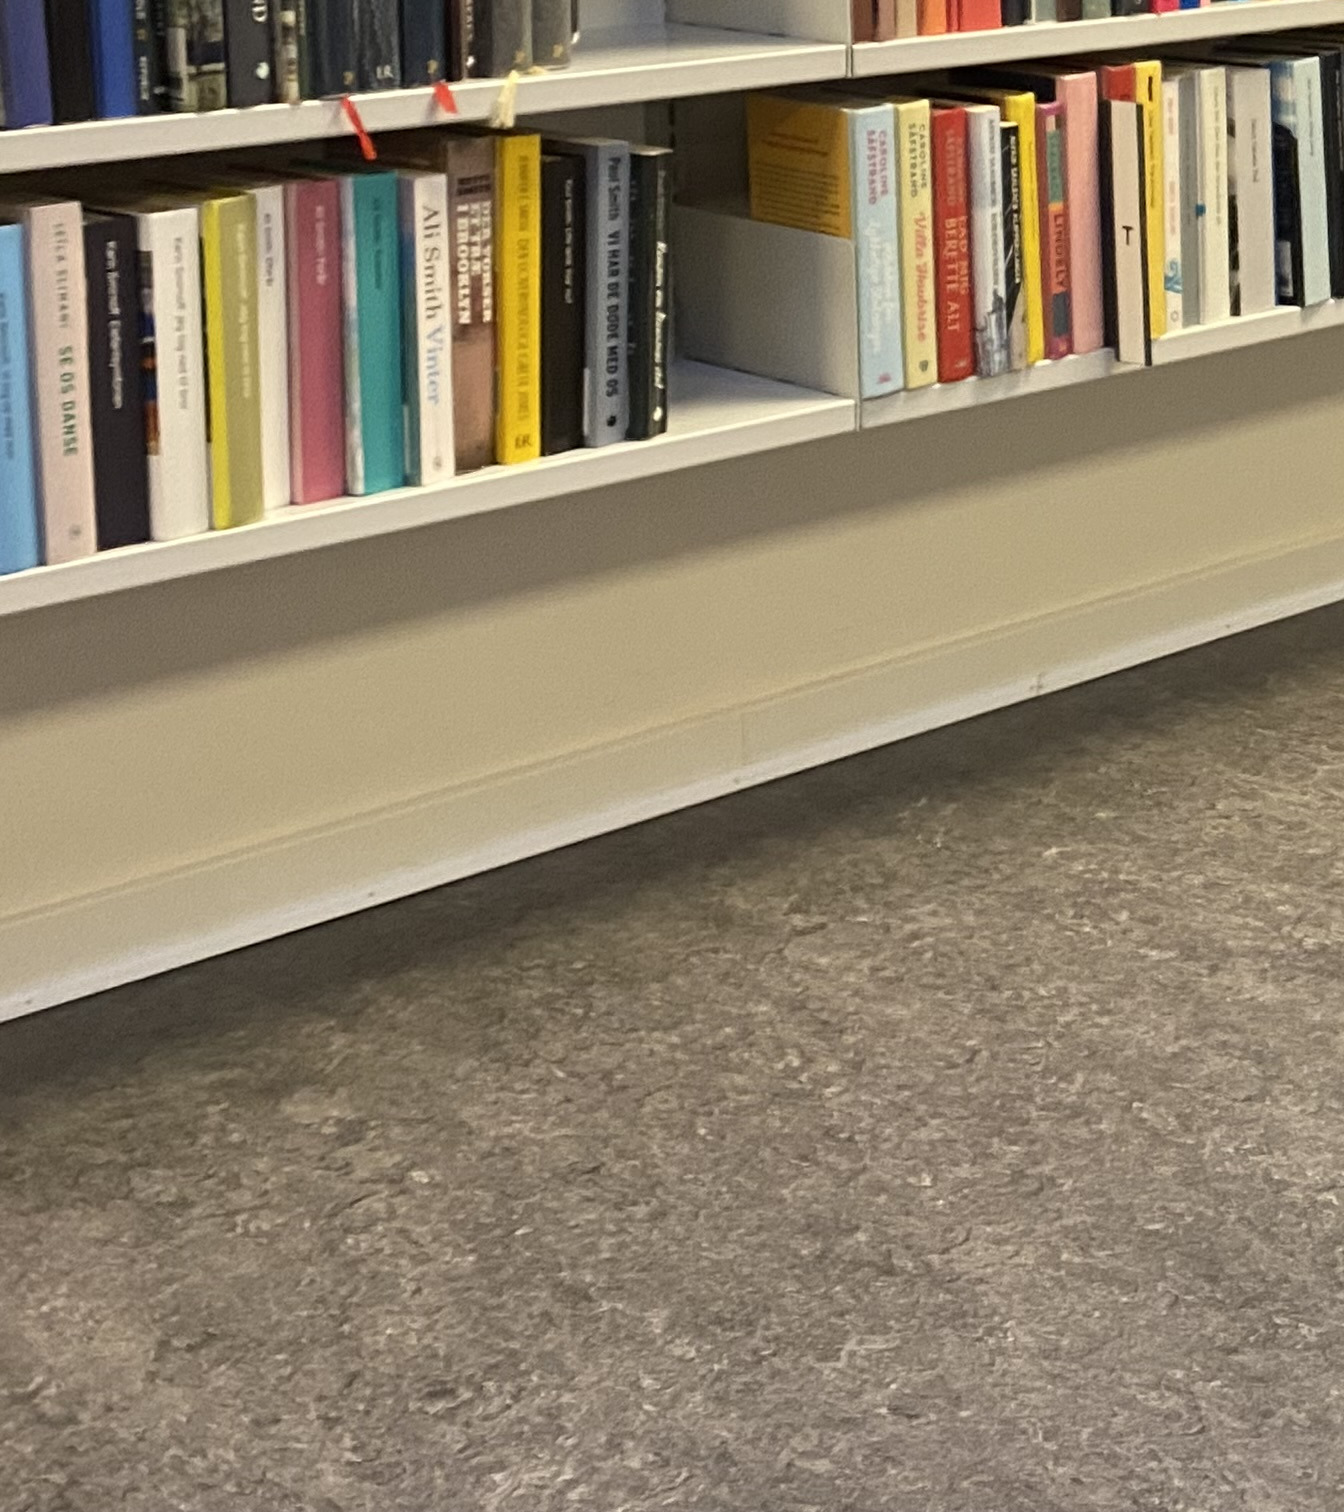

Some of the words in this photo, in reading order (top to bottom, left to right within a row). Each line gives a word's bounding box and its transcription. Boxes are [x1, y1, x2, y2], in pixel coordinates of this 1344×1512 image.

[607, 156, 620, 184] Paul
[879, 130, 889, 197] CAROLINE
[908, 122, 919, 198] SÄFSTRAND
[607, 186, 621, 221] Smith
[421, 206, 442, 238] Ali
[606, 231, 620, 247] VI
[944, 218, 960, 291] BERETTE
[456, 216, 471, 325] BROOKLYN
[606, 249, 619, 278] HAR
[423, 245, 445, 320] Smith
[946, 300, 960, 332] ALT
[59, 345, 76, 368] SE
[426, 324, 449, 405] Vinter
[605, 345, 619, 375] MED
[59, 372, 76, 395] OS
[605, 379, 619, 398] OS
[60, 400, 79, 457] DANSE
